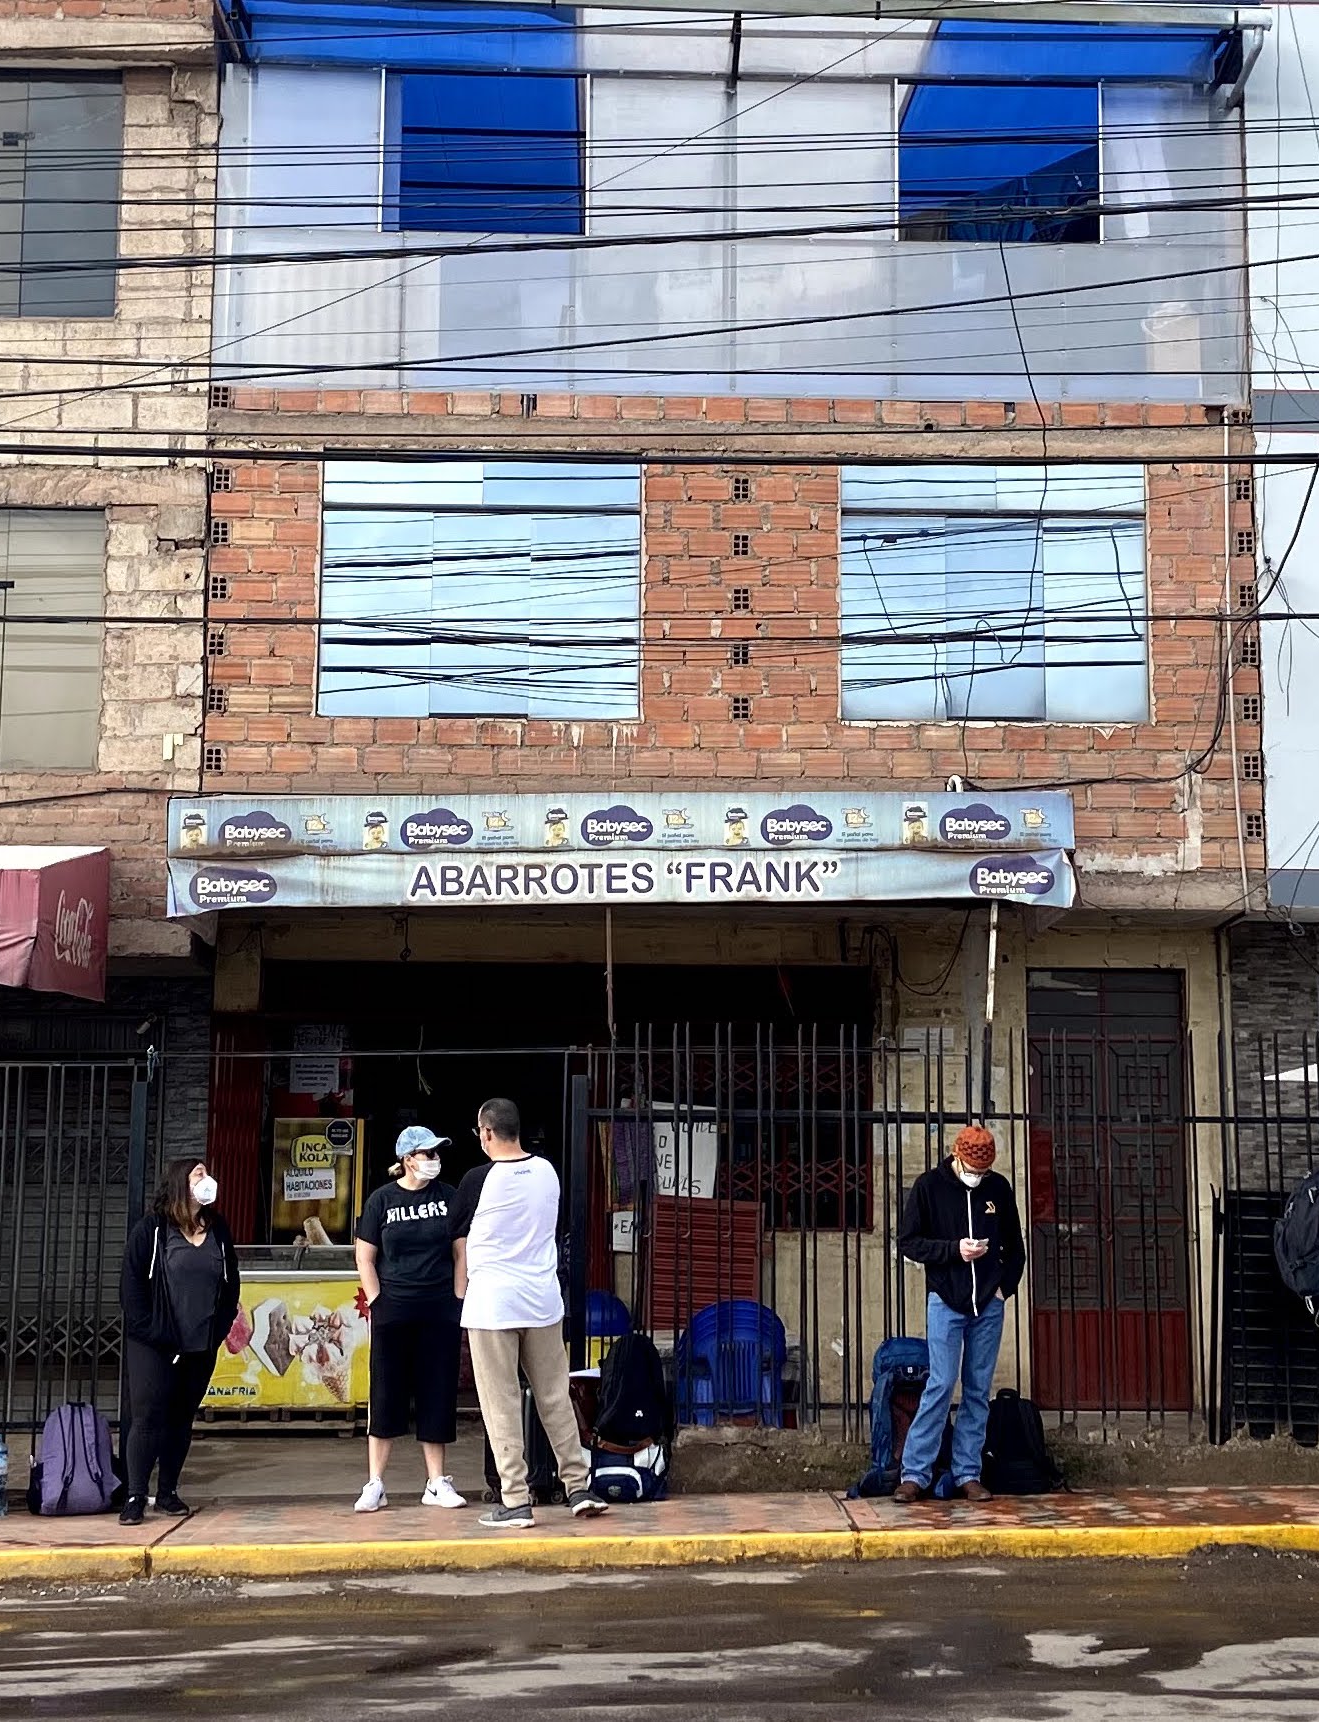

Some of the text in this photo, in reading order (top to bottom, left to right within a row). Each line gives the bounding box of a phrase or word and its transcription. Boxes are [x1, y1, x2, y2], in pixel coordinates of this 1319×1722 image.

[224, 824, 286, 841] Babysec
[406, 822, 468, 838] Babysec
[587, 819, 648, 835] Babysec
[766, 818, 827, 834] Babysec
[945, 817, 1006, 833] Babysec
[408, 836, 448, 844] Premium
[588, 833, 628, 841] Premium
[768, 832, 808, 840] Premium
[947, 832, 987, 840] Premium
[410, 862, 654, 897] ABARROTES
[976, 867, 1049, 887] Babysec
[196, 877, 270, 895] Babysec
[979, 885, 1026, 894] Premium
[199, 894, 247, 903] Premium
[301, 1142, 328, 1152] INCA
[299, 1152, 329, 1163] KOLA
[386, 1200, 448, 1225] KILLERS
